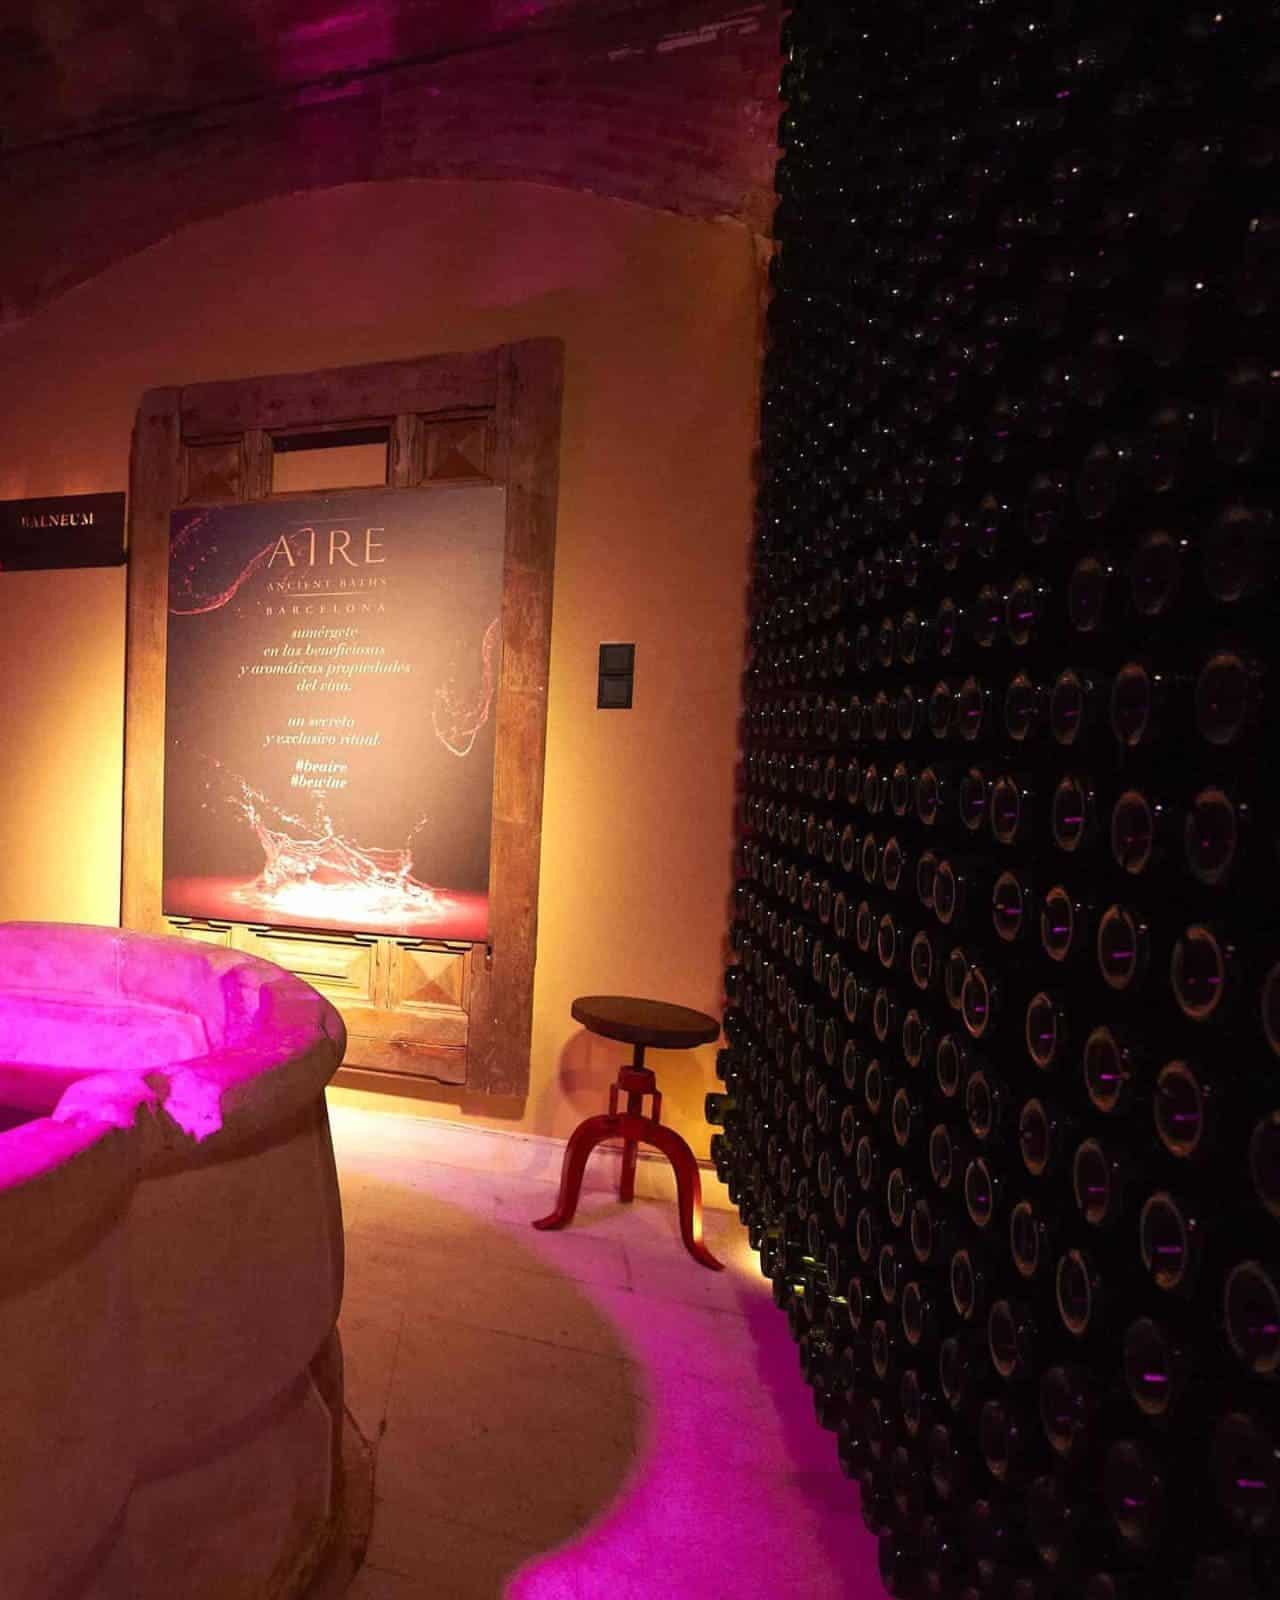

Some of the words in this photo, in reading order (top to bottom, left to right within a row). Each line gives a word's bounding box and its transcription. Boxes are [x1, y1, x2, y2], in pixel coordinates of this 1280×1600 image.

[21, 512, 94, 528] BALNEUM
[267, 527, 386, 568] AIRE
[267, 578, 332, 593] ANCIENT
[266, 603, 387, 617] BARCELONA
[263, 647, 279, 657] en
[296, 679, 317, 692] del
[320, 681, 352, 693] vino.
[288, 717, 305, 727] un
[309, 715, 355, 728] secreto
[276, 732, 337, 745] exclusivo
[290, 774, 347, 788] #bewine
